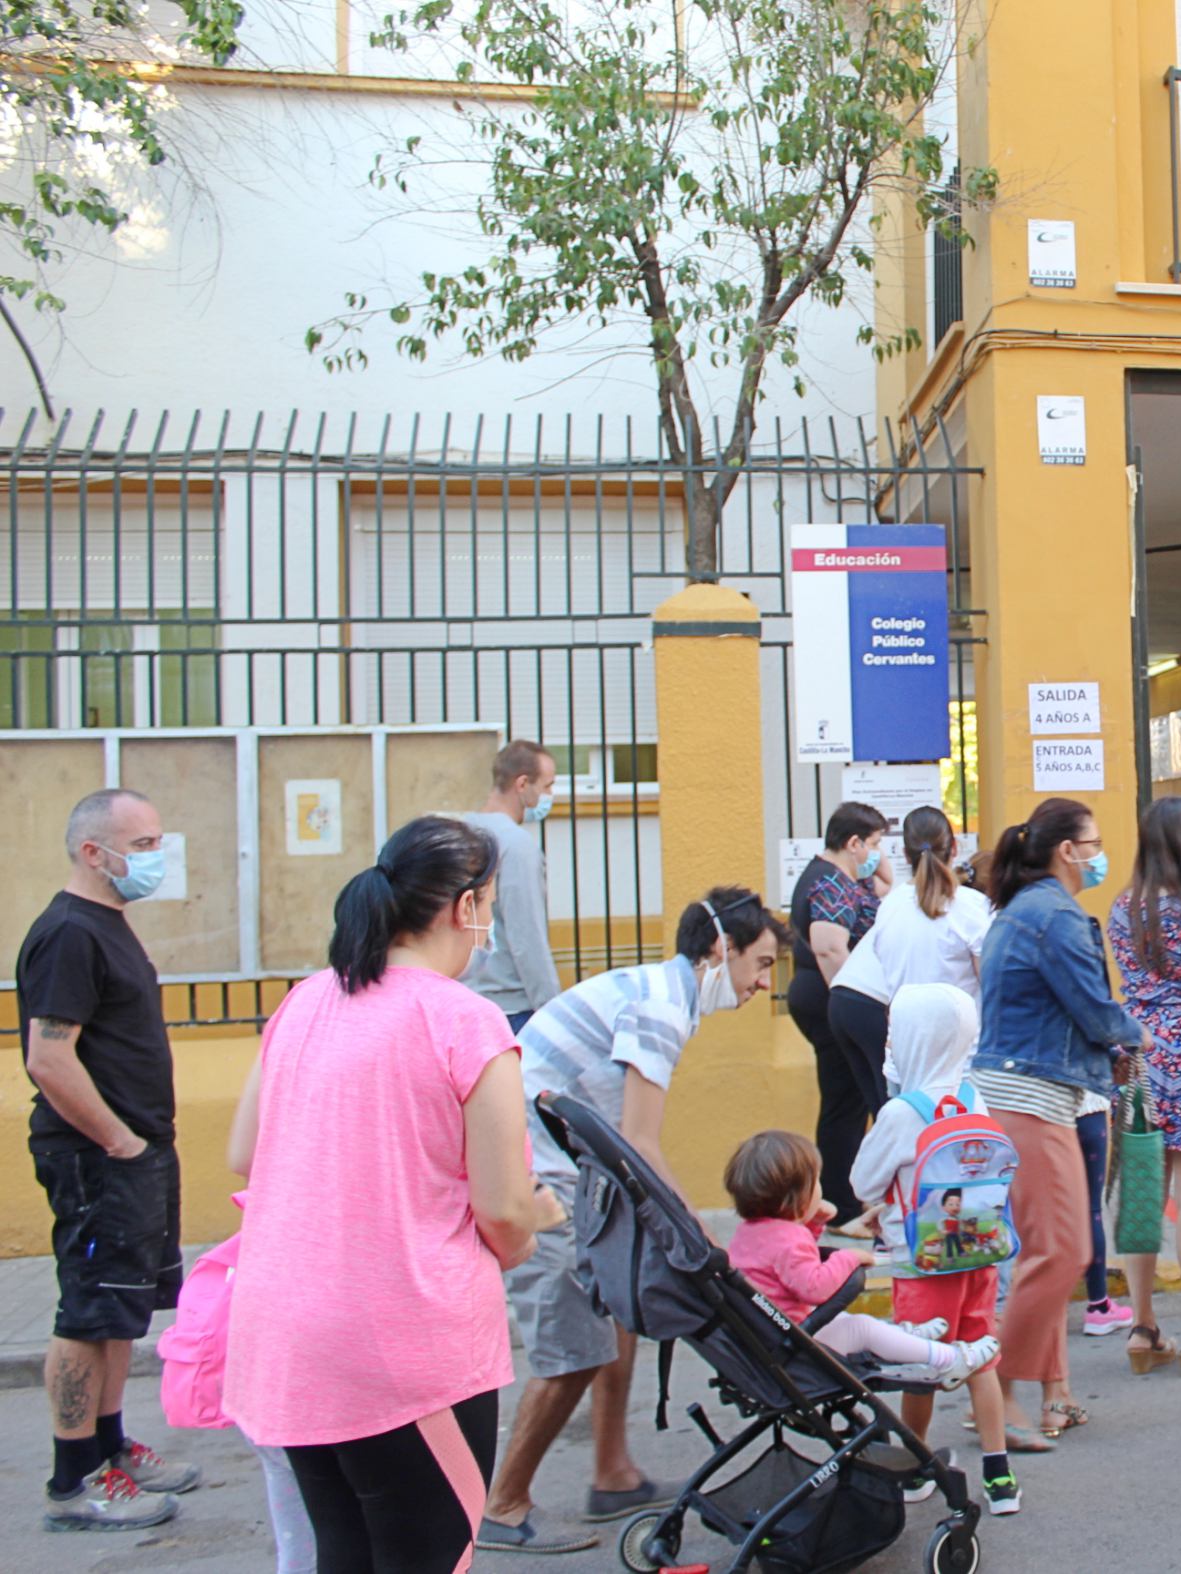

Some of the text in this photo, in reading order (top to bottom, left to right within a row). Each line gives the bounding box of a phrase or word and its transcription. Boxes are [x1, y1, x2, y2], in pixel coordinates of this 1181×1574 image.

[814, 552, 901, 567] Educación
[871, 617, 926, 632] Colegio
[872, 634, 925, 647] Público
[863, 653, 936, 665] Cervantes
[1037, 689, 1087, 702] SALIDA
[1035, 711, 1092, 723] 4 AÑOS A
[1036, 745, 1093, 756] ENTRADA
[1036, 763, 1042, 772] 5
[1044, 761, 1073, 772] AÑOS
